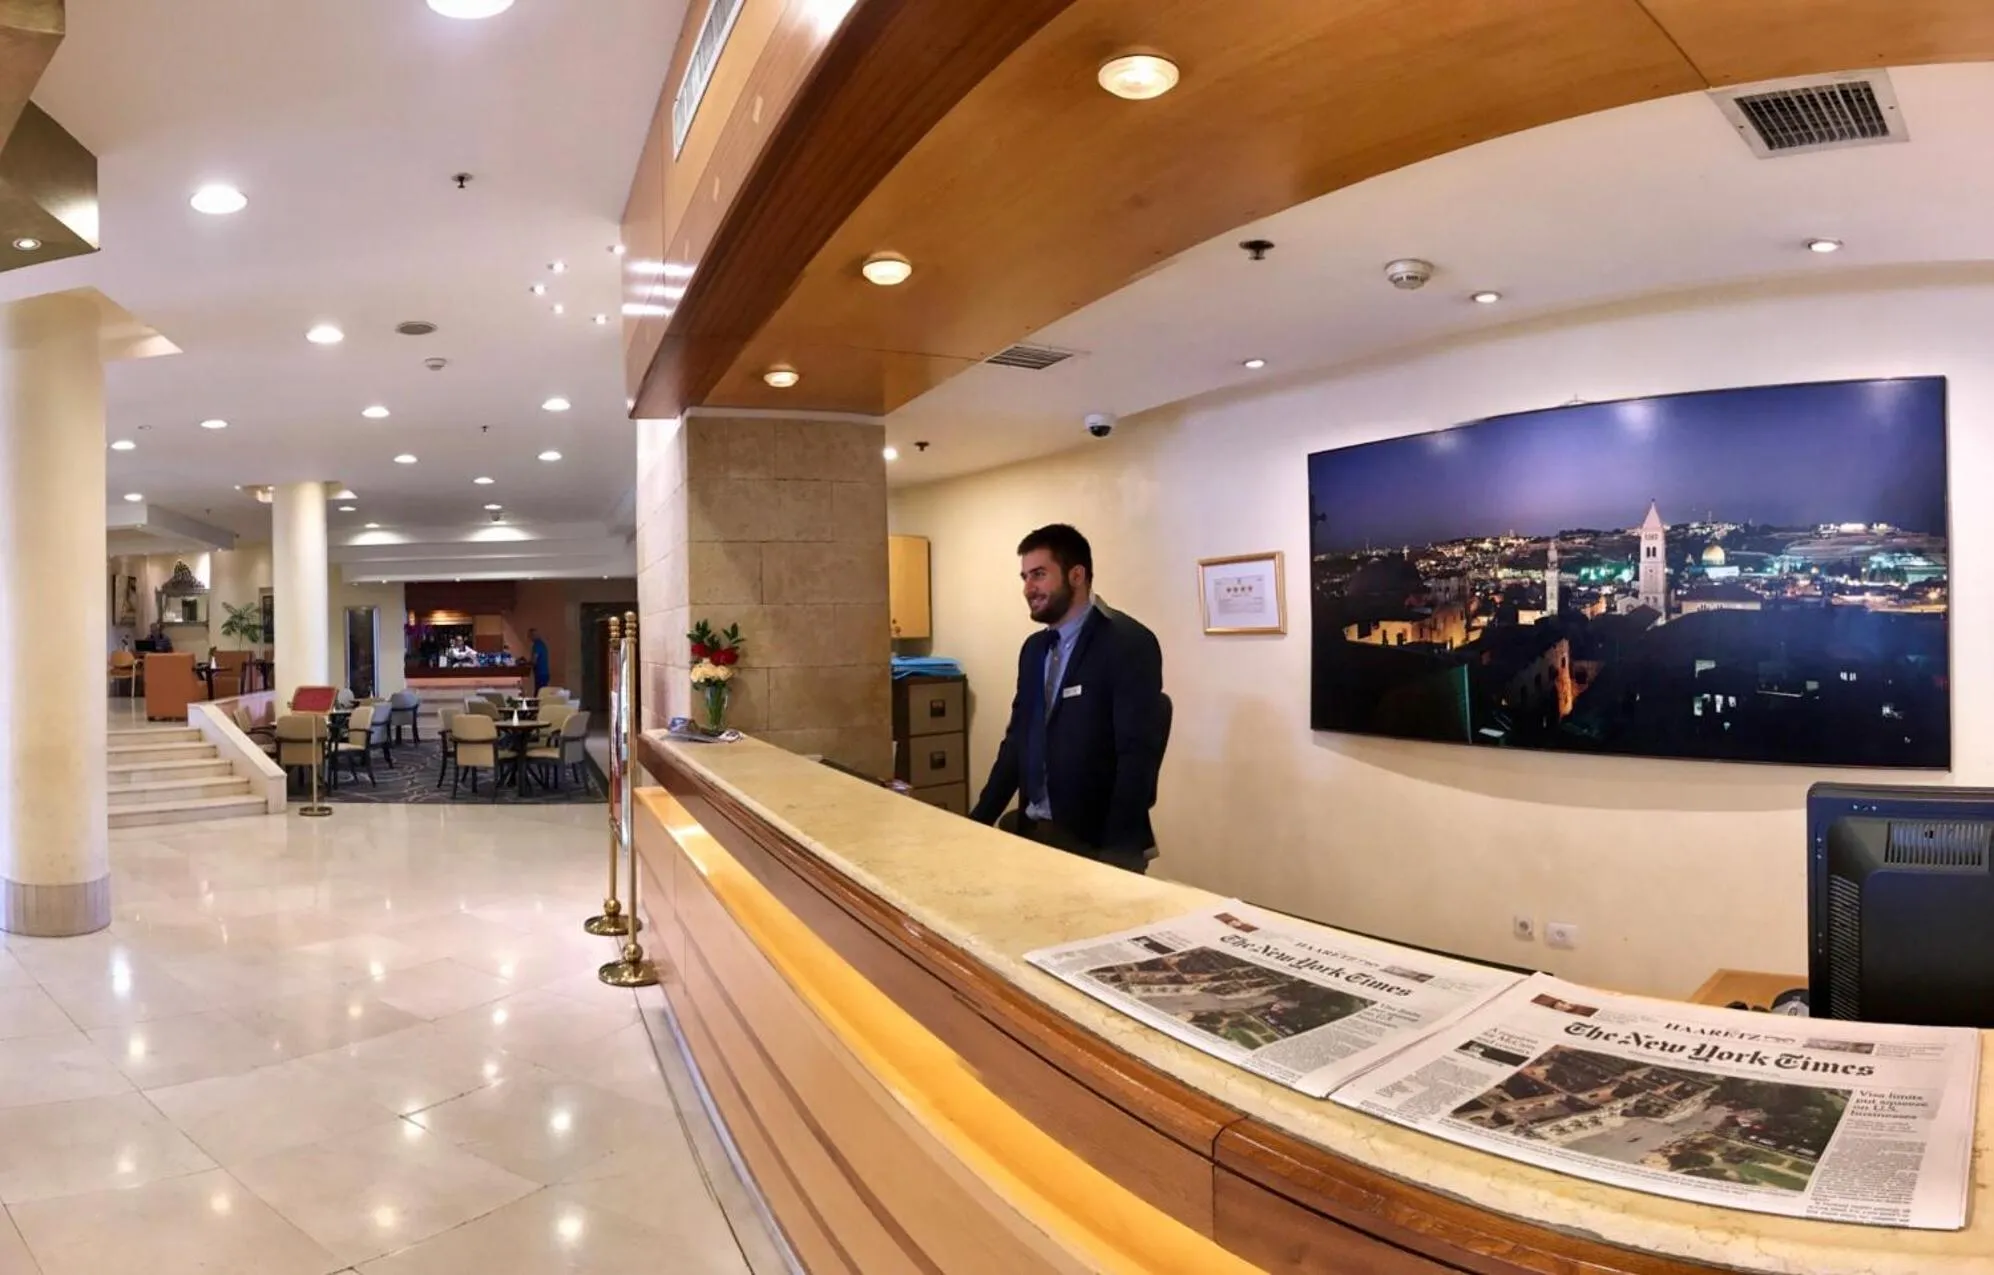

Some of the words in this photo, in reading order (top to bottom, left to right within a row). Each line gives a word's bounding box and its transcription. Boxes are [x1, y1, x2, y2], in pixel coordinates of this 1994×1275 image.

[1220, 934, 1255, 950] The
[1251, 943, 1293, 963] New
[1289, 956, 1346, 979] York
[1344, 972, 1414, 997] Times
[1563, 1021, 1618, 1041] The
[1617, 1031, 1687, 1053] New
[1687, 1042, 1771, 1067] York
[1774, 1052, 1875, 1077] Times
